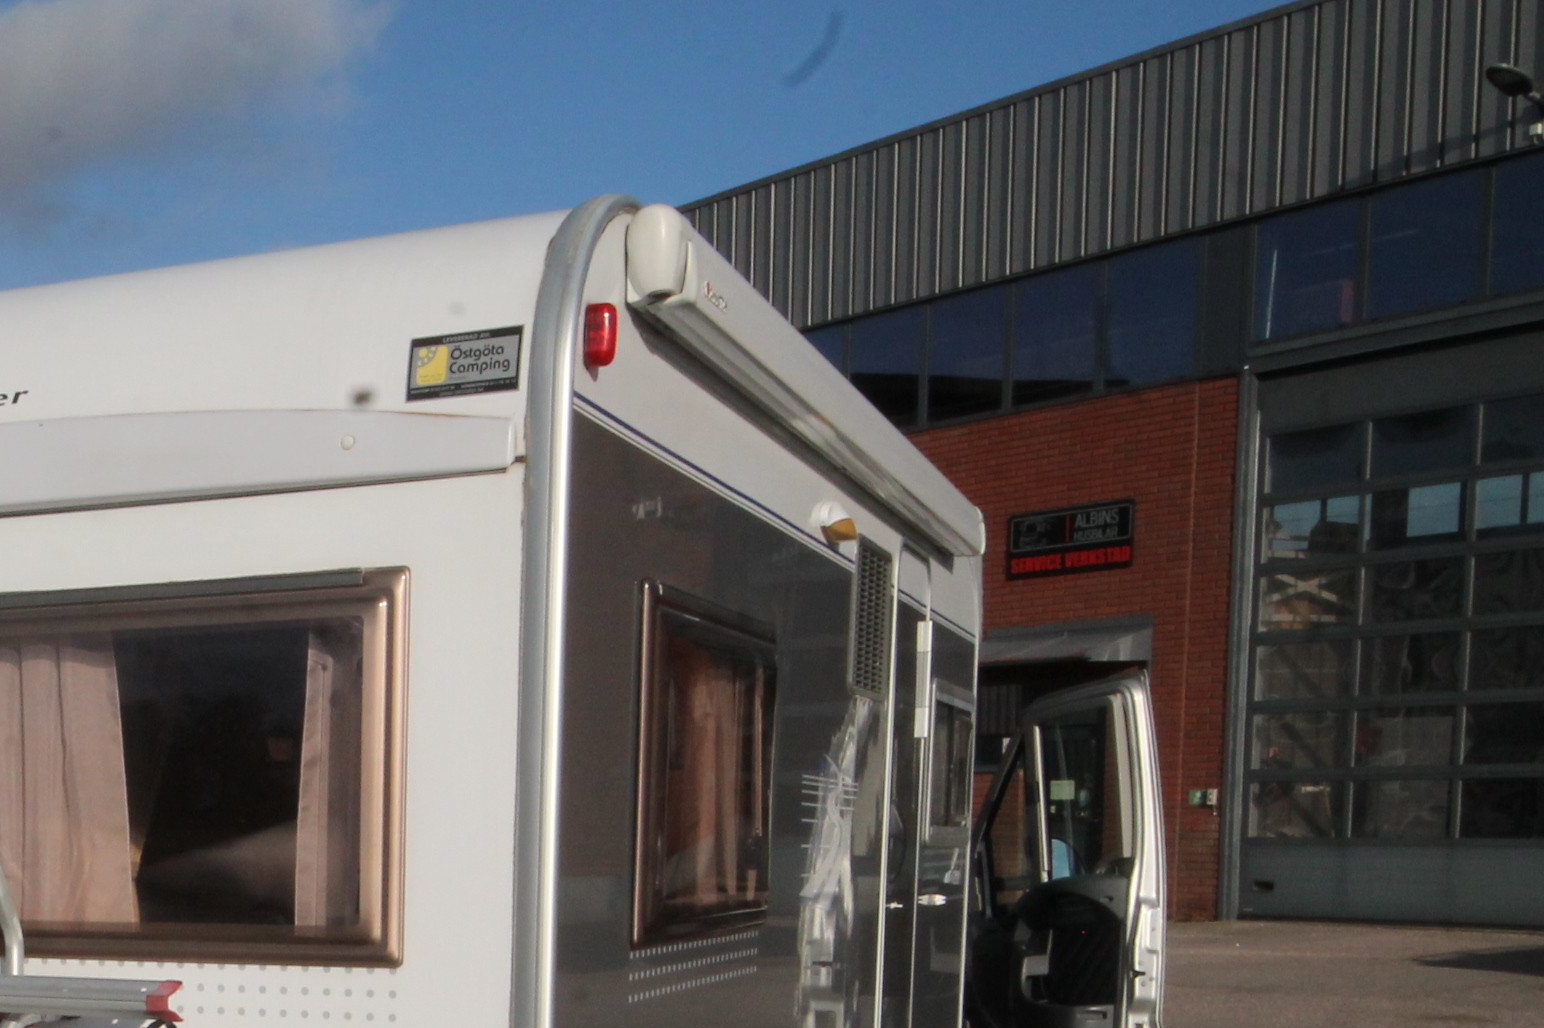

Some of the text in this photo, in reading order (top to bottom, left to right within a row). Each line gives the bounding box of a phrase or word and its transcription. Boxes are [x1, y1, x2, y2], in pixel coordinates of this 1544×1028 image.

[450, 344, 504, 361] Östgöta
[449, 357, 510, 374] Camping
[1074, 508, 1119, 528] ALBINS
[1010, 553, 1062, 575] SERVICE
